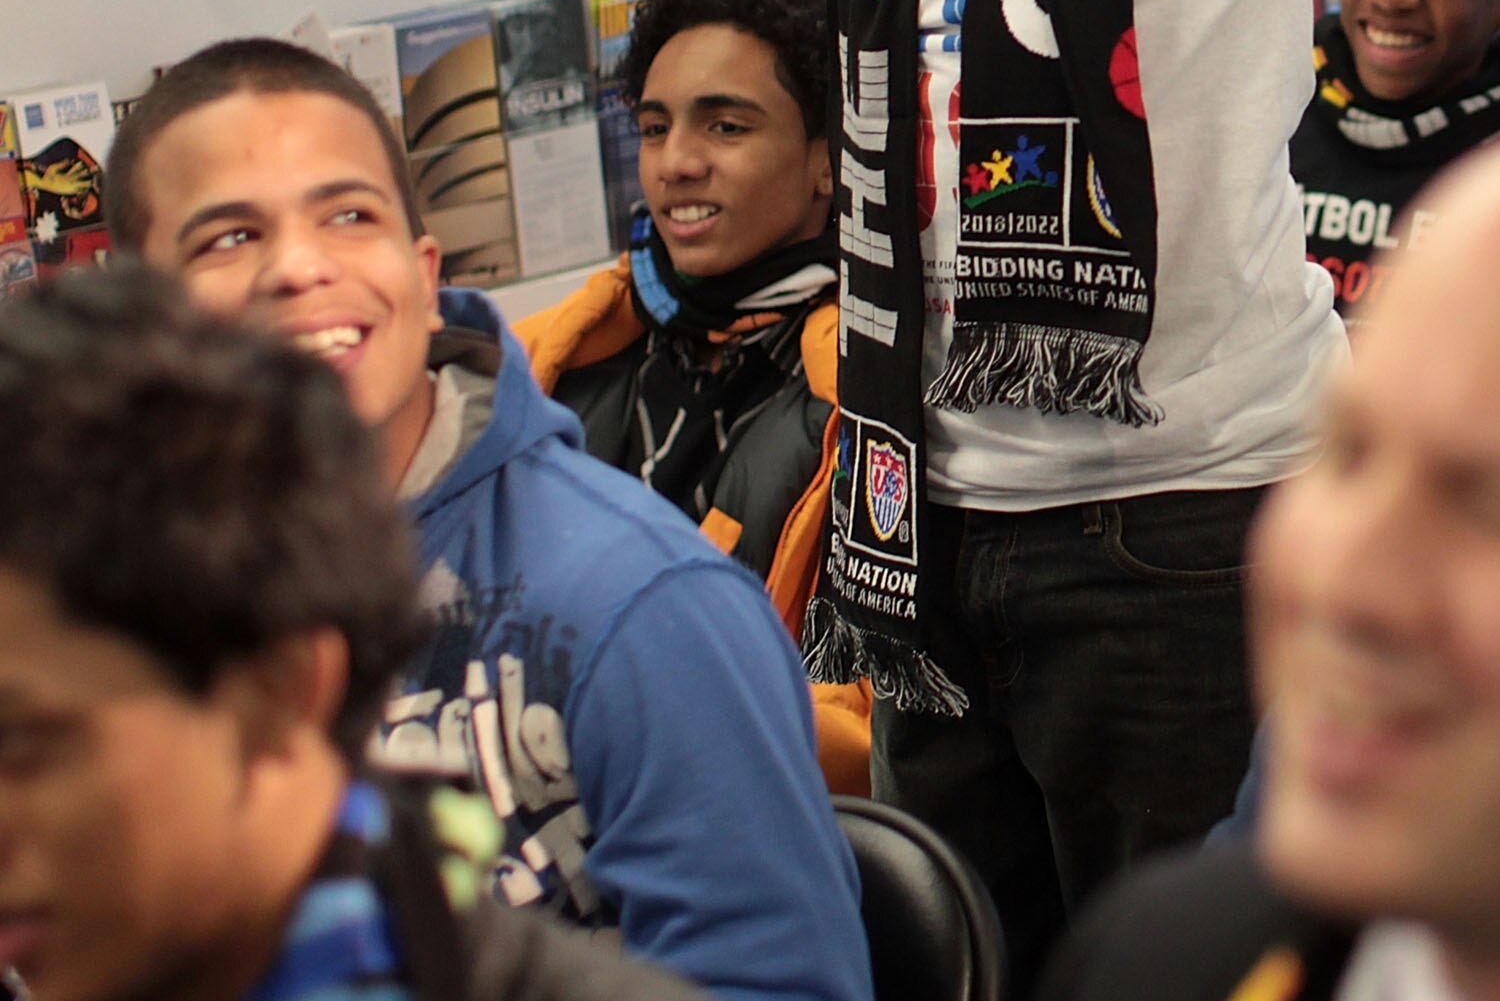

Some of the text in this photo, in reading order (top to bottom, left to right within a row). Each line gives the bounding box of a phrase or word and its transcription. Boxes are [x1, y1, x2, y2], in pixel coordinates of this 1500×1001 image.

[1297, 184, 1400, 249] TBOL
[957, 254, 1147, 290] BIDDING NATI
[954, 280, 1012, 301] UNITED
[1016, 281, 1074, 302] STATES
[1077, 288, 1100, 307] OF
[847, 554, 919, 597] NATION
[858, 587, 918, 620] AMERICA
